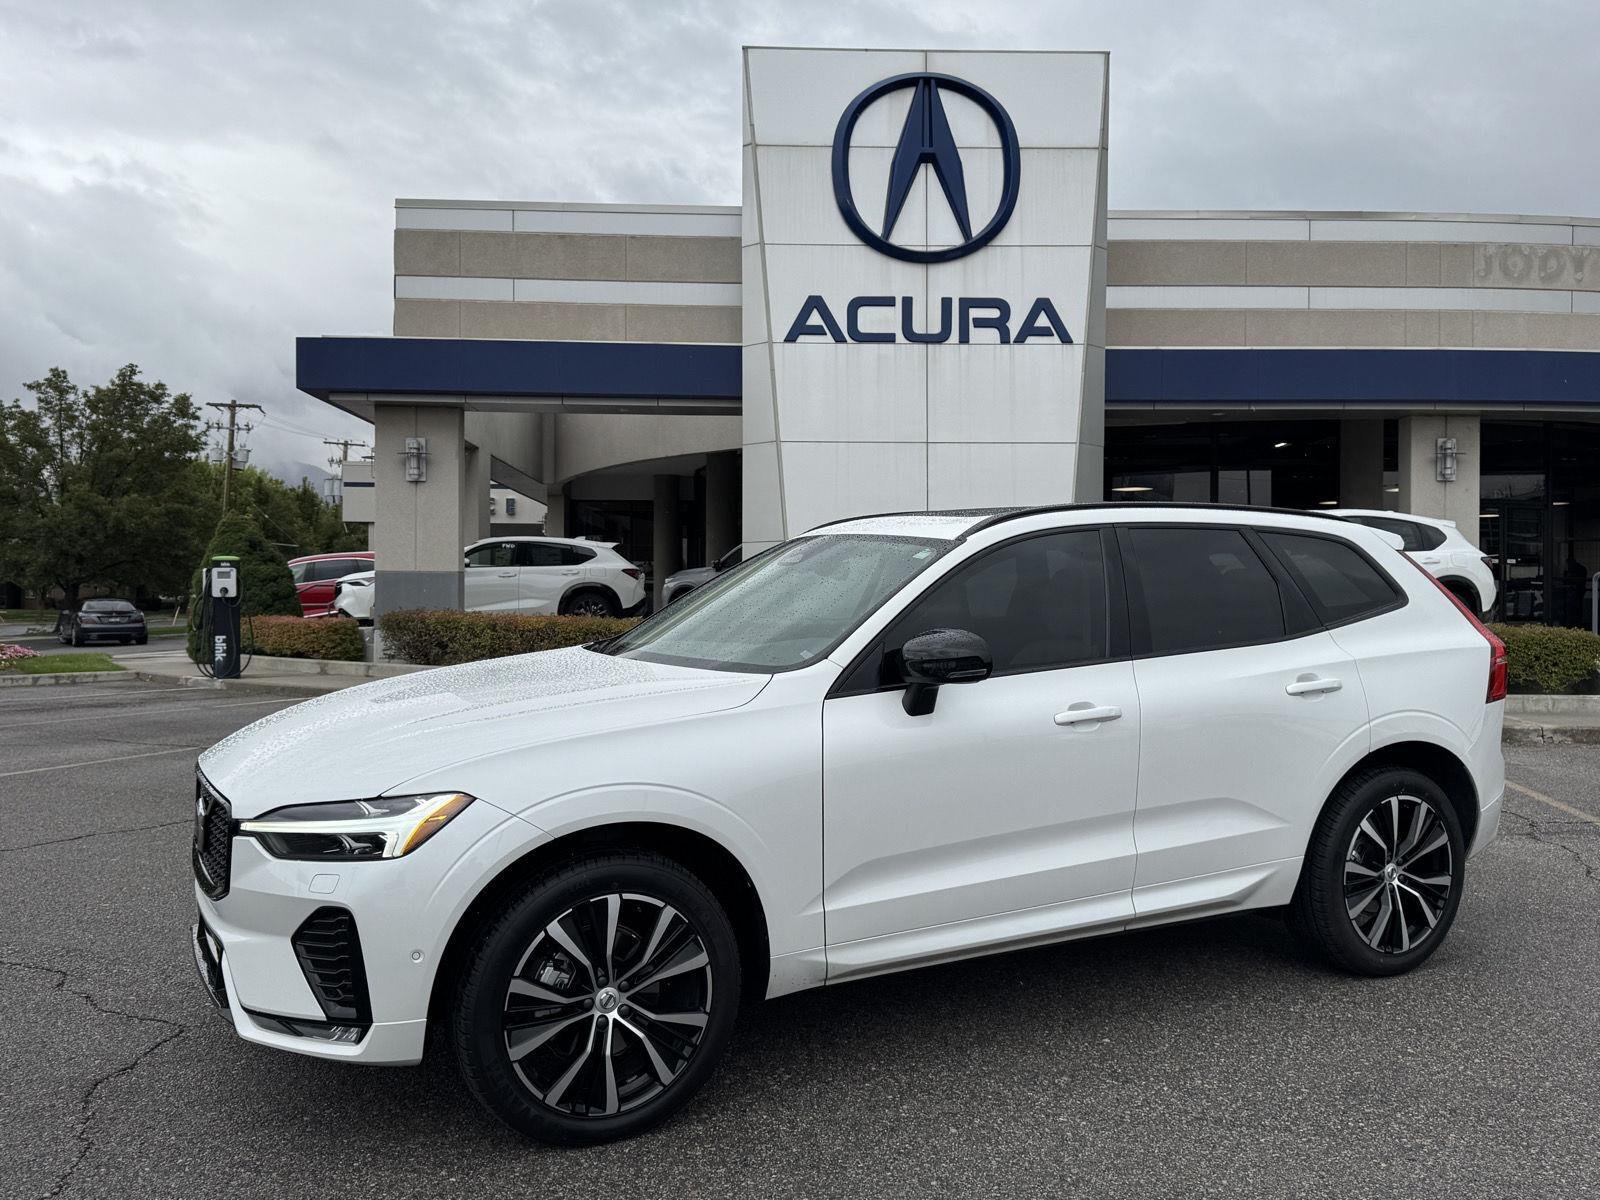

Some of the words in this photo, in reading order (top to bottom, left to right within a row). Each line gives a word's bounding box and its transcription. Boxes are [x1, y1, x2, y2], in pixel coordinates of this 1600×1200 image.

[1479, 244, 1593, 282] JODY
[783, 295, 1074, 344] ACURA
[214, 635, 227, 661] blink
